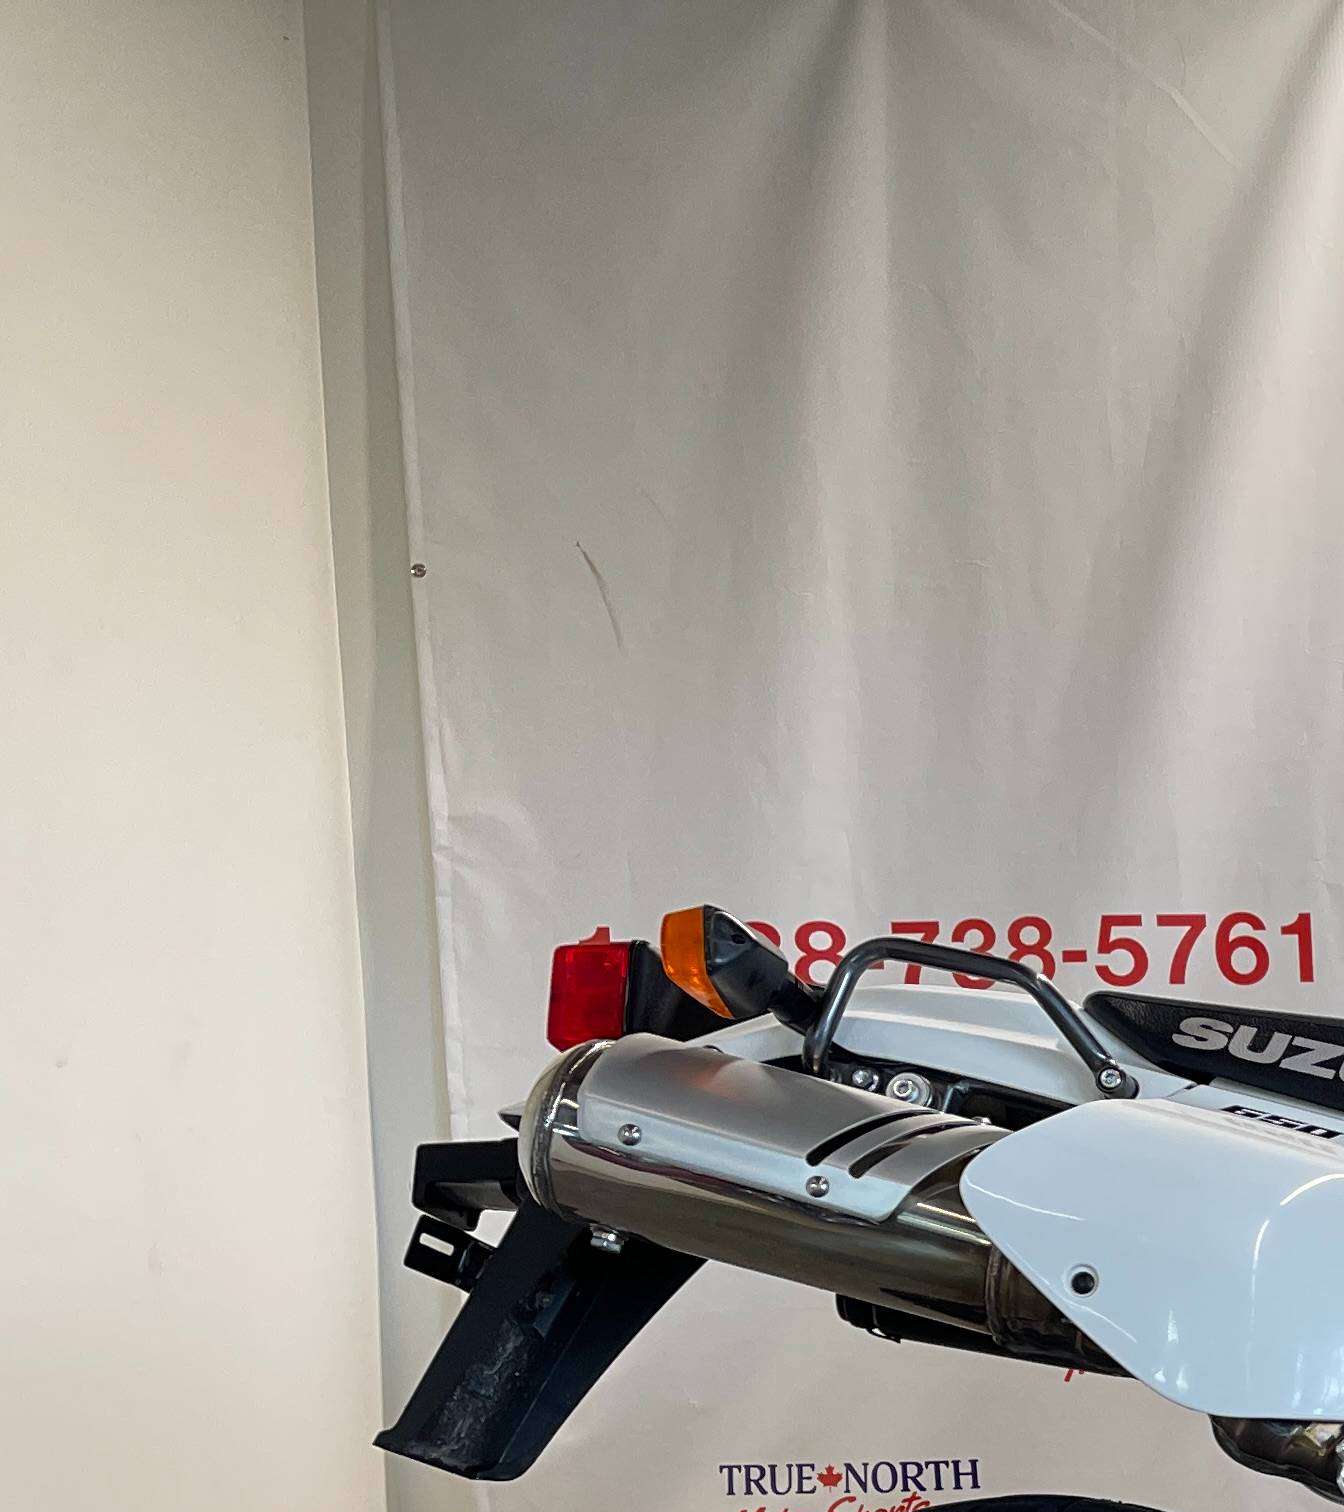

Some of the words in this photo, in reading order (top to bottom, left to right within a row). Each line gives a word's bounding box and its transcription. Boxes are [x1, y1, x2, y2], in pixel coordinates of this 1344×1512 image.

[1221, 1105, 1344, 1139] 650
[719, 1463, 818, 1496] TRUE
[843, 1459, 981, 1494] NORTH
